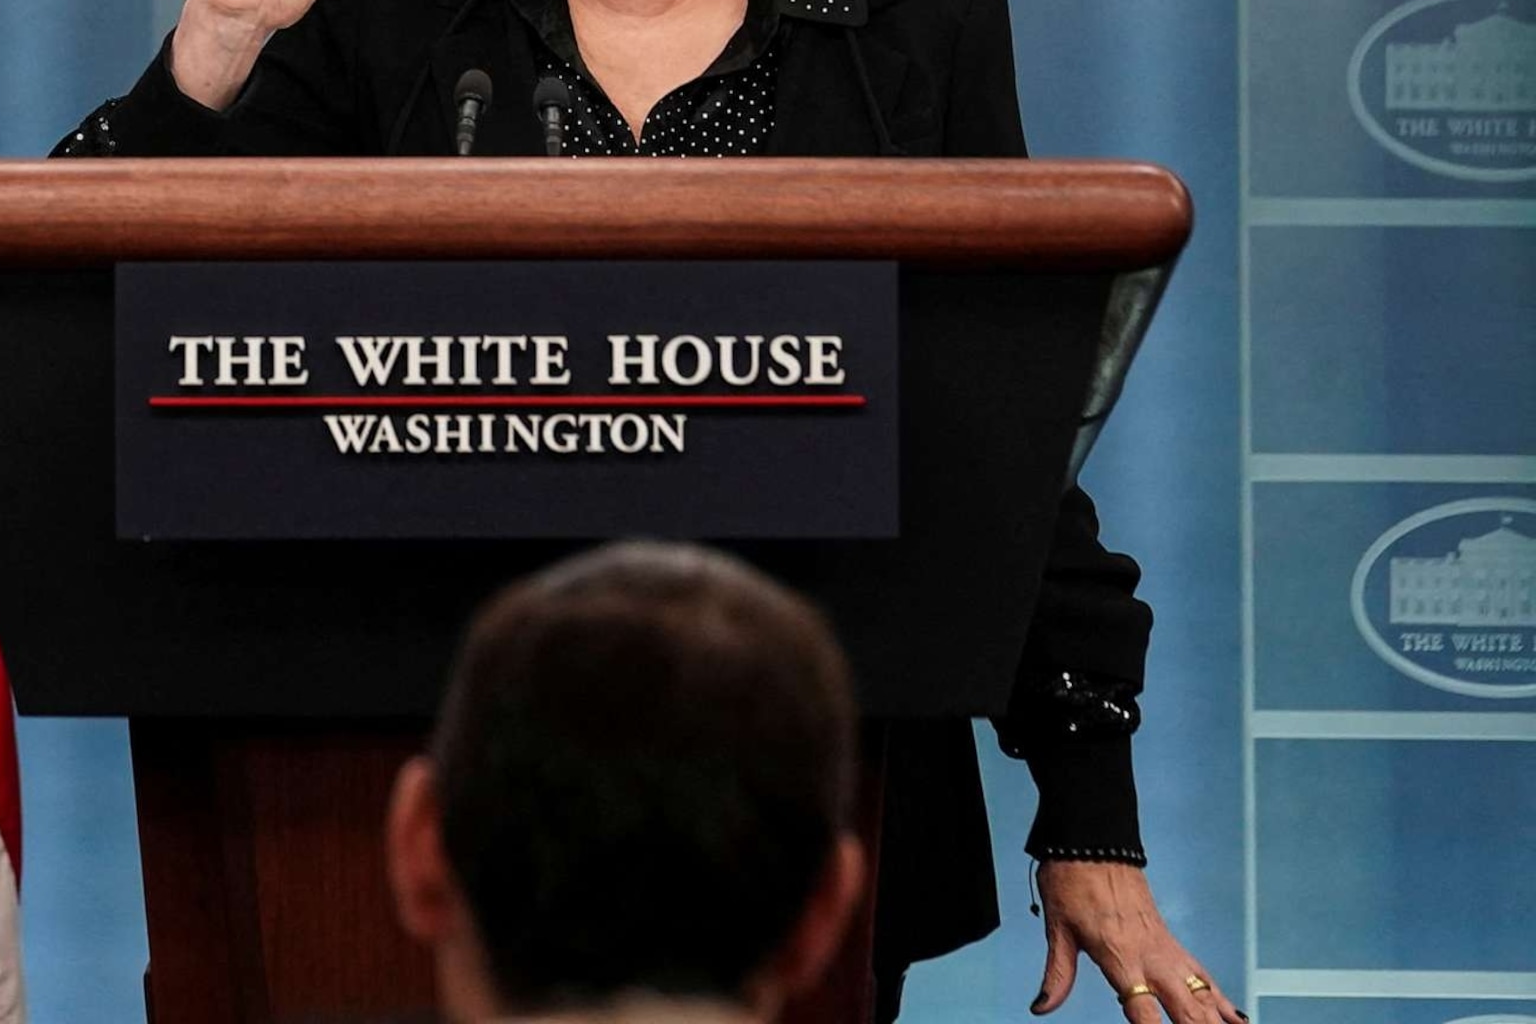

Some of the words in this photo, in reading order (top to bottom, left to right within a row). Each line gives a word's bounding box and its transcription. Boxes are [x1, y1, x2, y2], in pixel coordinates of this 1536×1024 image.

[1396, 117, 1440, 137] THE
[1446, 117, 1518, 137] WHITE
[169, 335, 309, 386] THE
[335, 335, 571, 386] WHITE
[607, 334, 846, 386] HOUSE
[323, 413, 687, 454] WASHINGTON
[1400, 632, 1445, 652] THE
[1451, 632, 1524, 652] WHITE
